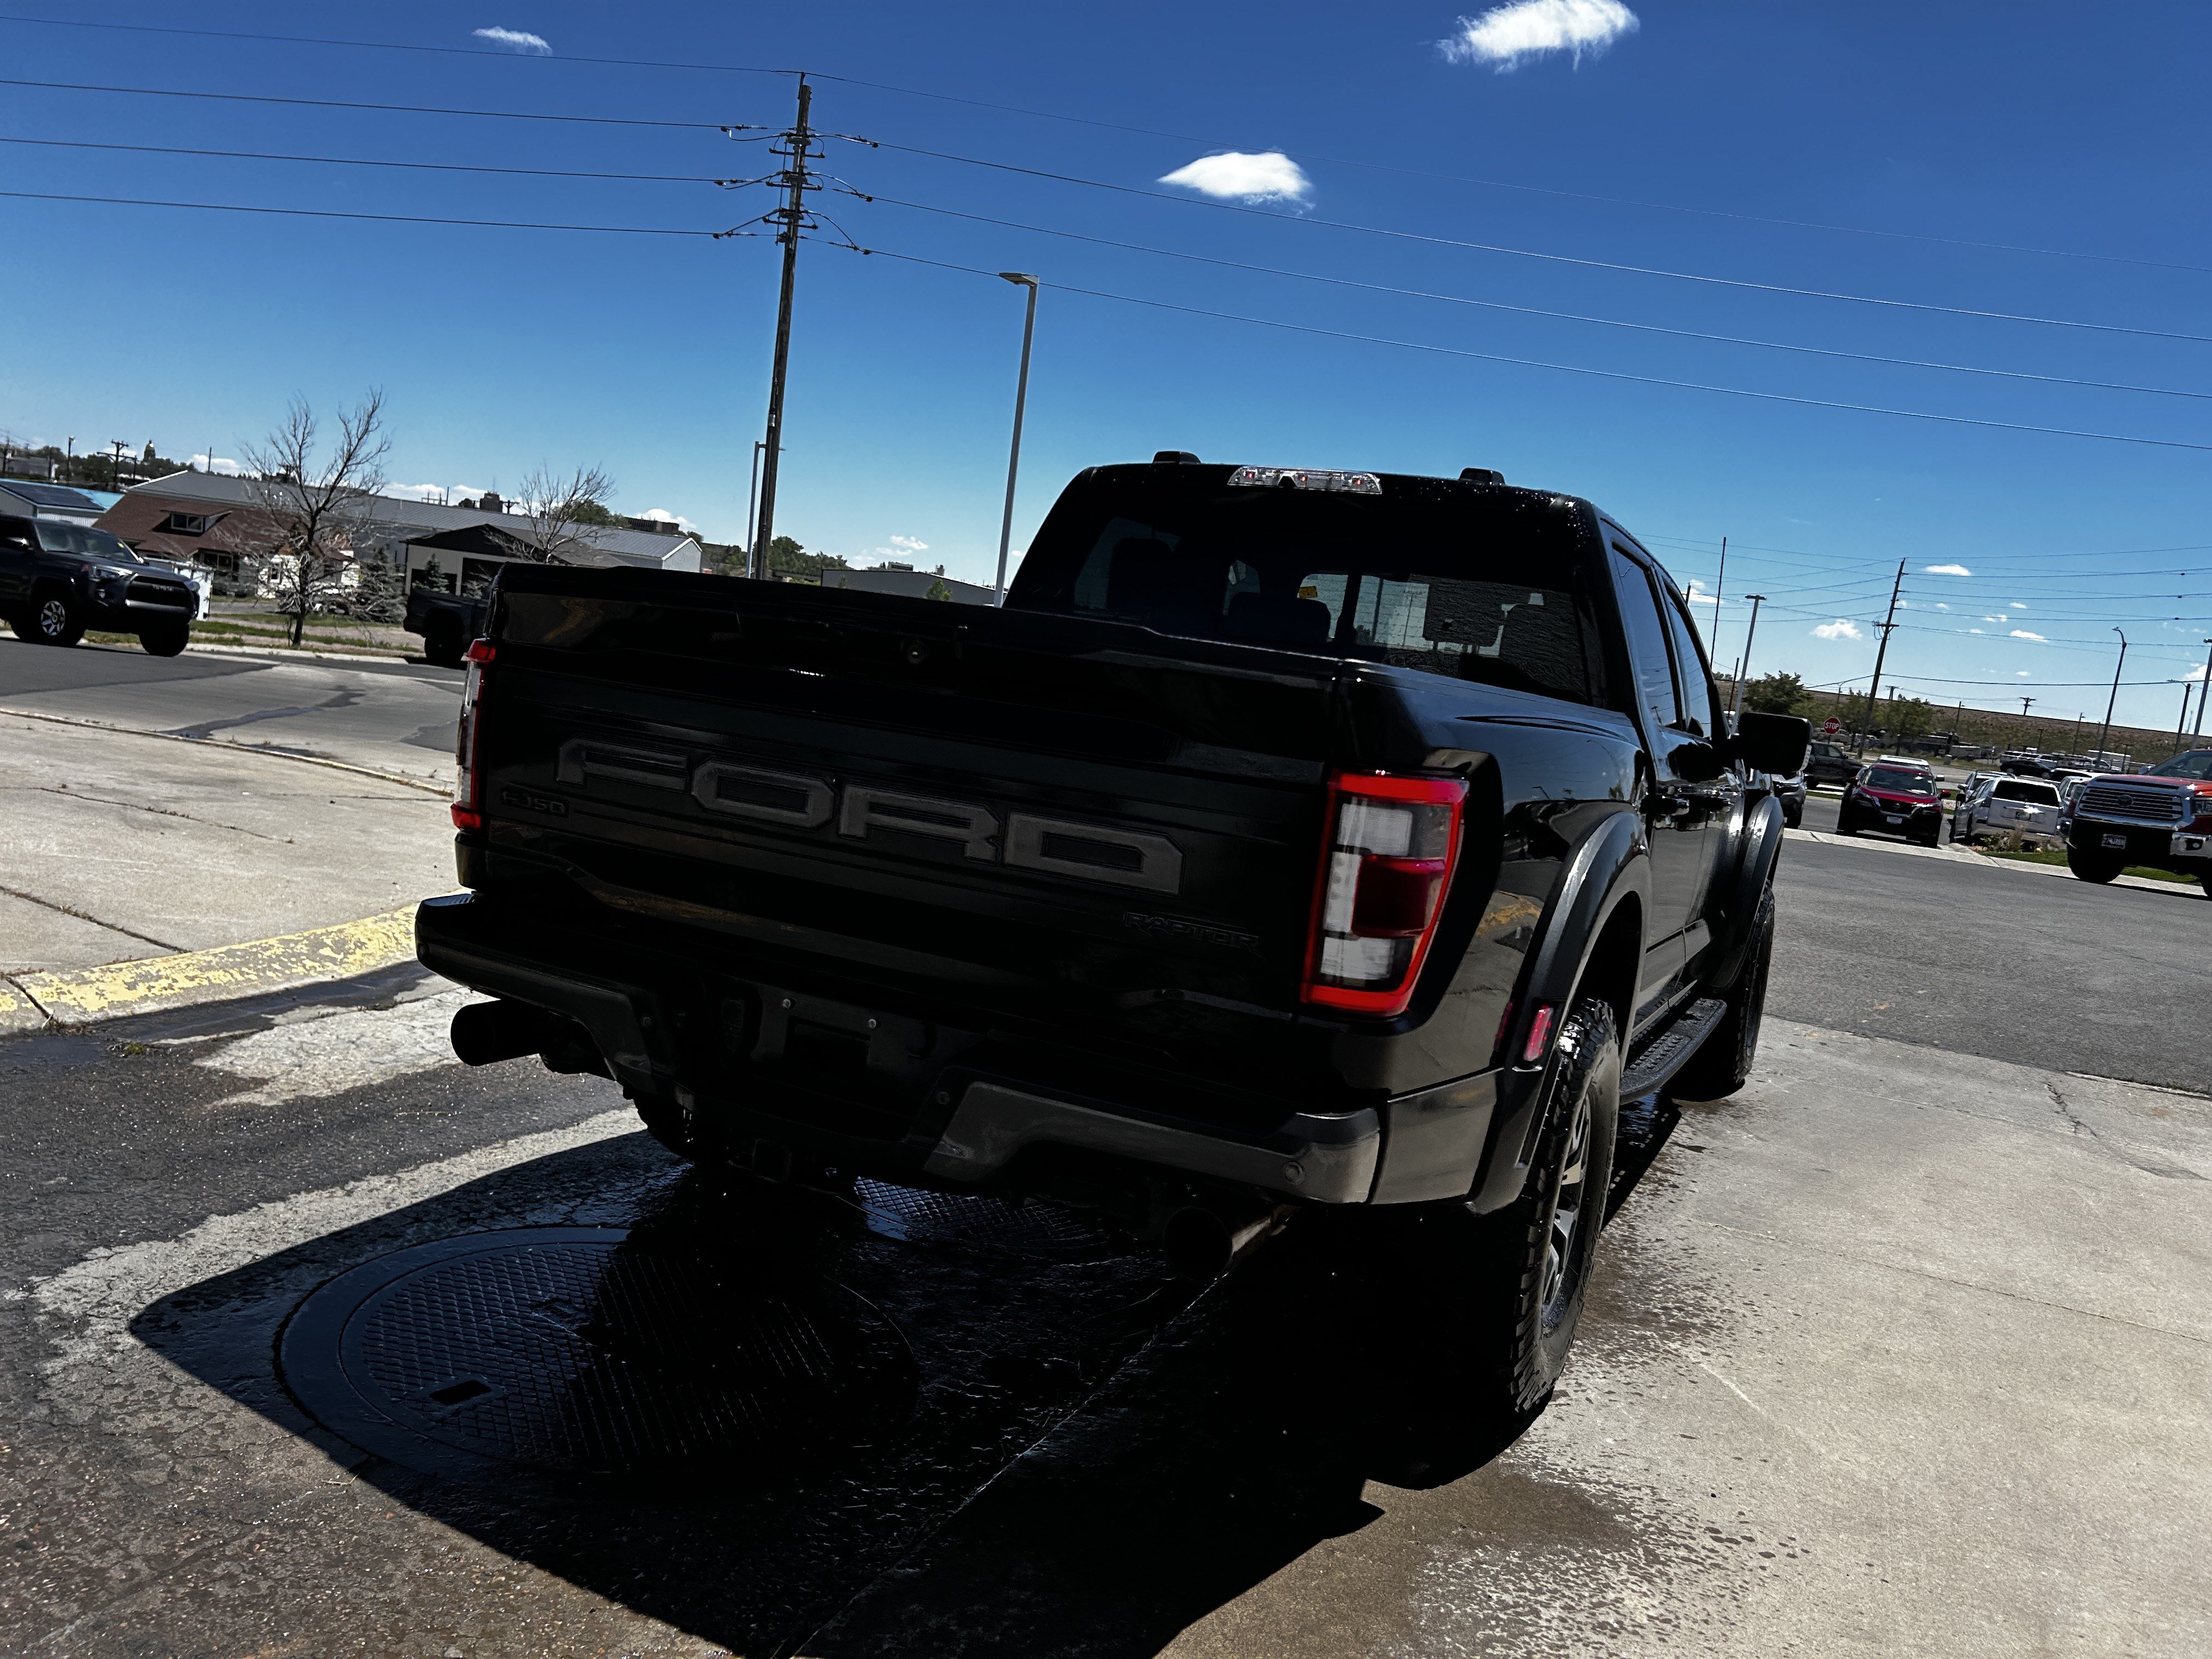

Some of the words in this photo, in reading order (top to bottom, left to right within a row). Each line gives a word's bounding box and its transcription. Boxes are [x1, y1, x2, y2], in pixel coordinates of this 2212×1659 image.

[1825, 721, 1839, 730] STOP
[557, 736, 1185, 898] FORD
[1124, 911, 1265, 957] RAPTOR
